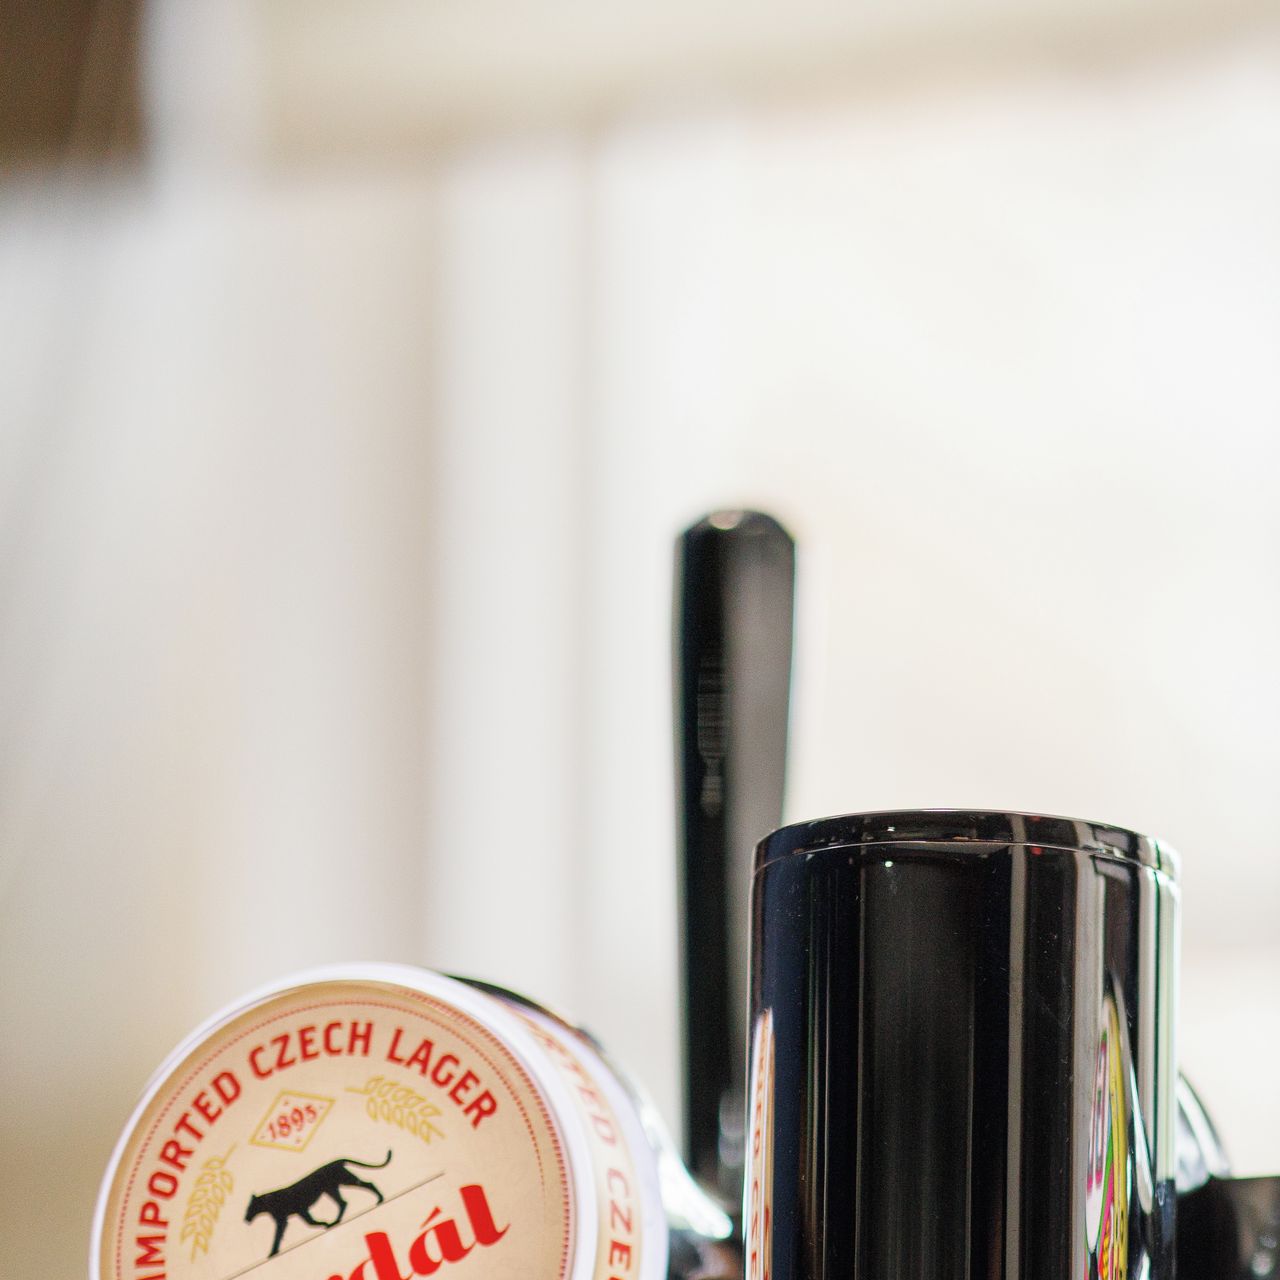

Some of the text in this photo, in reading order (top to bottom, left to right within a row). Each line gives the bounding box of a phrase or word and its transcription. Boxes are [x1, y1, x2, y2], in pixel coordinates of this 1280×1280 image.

[248, 1020, 374, 1080] CZECH
[386, 1027, 498, 1130] LAGER
[267, 1103, 319, 1143] 1895
